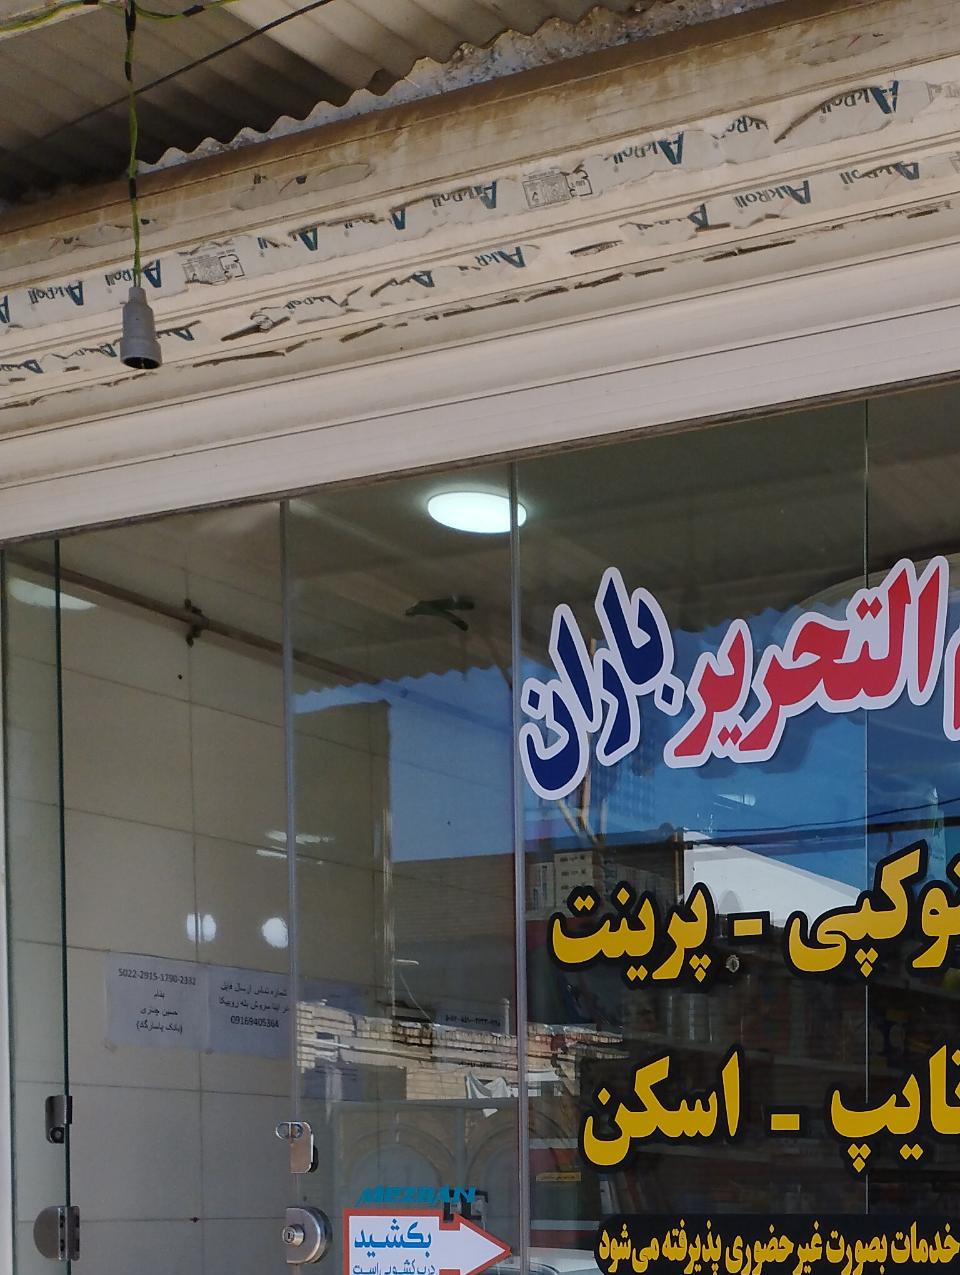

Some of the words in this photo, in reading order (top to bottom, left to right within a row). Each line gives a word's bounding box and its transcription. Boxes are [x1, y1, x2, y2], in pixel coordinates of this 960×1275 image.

[457, 247, 526, 271] AkR
[522, 569, 686, 797] باران
[666, 558, 949, 767] التحریر
[552, 887, 709, 982] پرینت
[583, 1051, 741, 1166] اسکن
[354, 1218, 432, 1258] بکشید
[725, 1227, 795, 1275] حضوری
[826, 1230, 887, 1275] بصورت
[891, 1220, 960, 1264] خدمات
[352, 1262, 379, 1275] است
